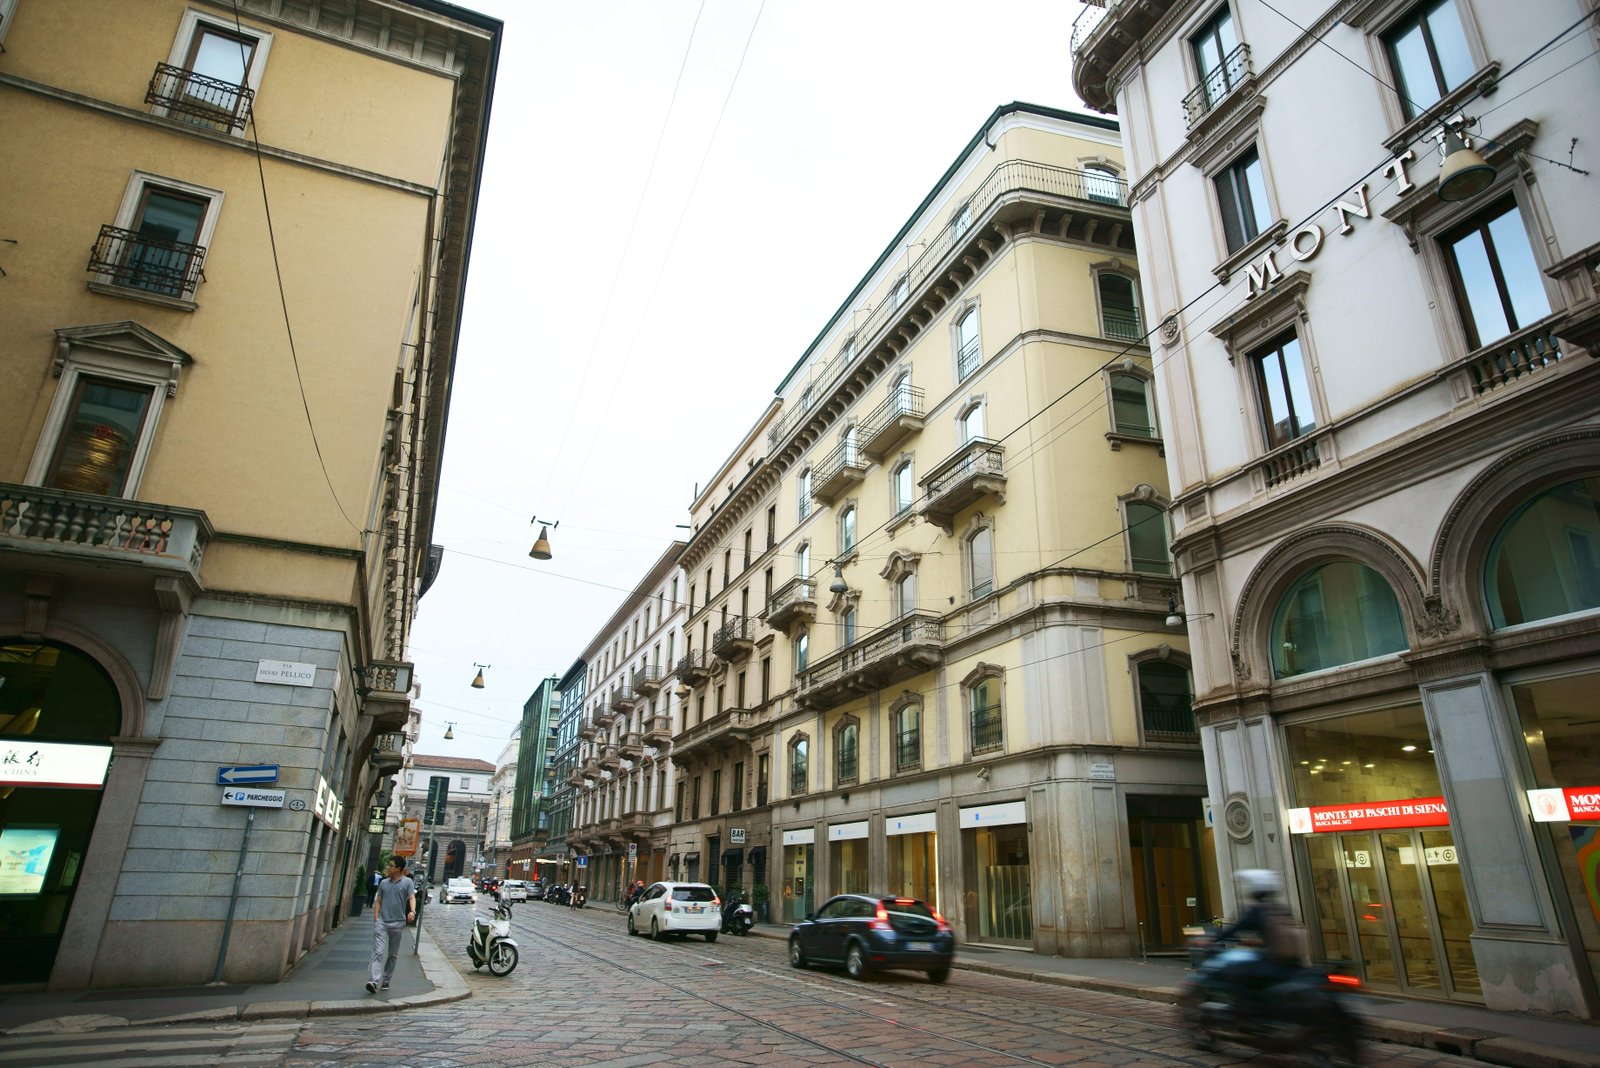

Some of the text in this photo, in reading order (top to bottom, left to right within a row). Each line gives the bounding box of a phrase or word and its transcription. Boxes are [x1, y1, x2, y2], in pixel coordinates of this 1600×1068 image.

[280, 670, 312, 679] PELLICO
[246, 793, 283, 802] PARCHEGGIO
[1314, 803, 1447, 820] MONTE DEI PASCHI DI SIENA
[732, 830, 744, 838] BAR
